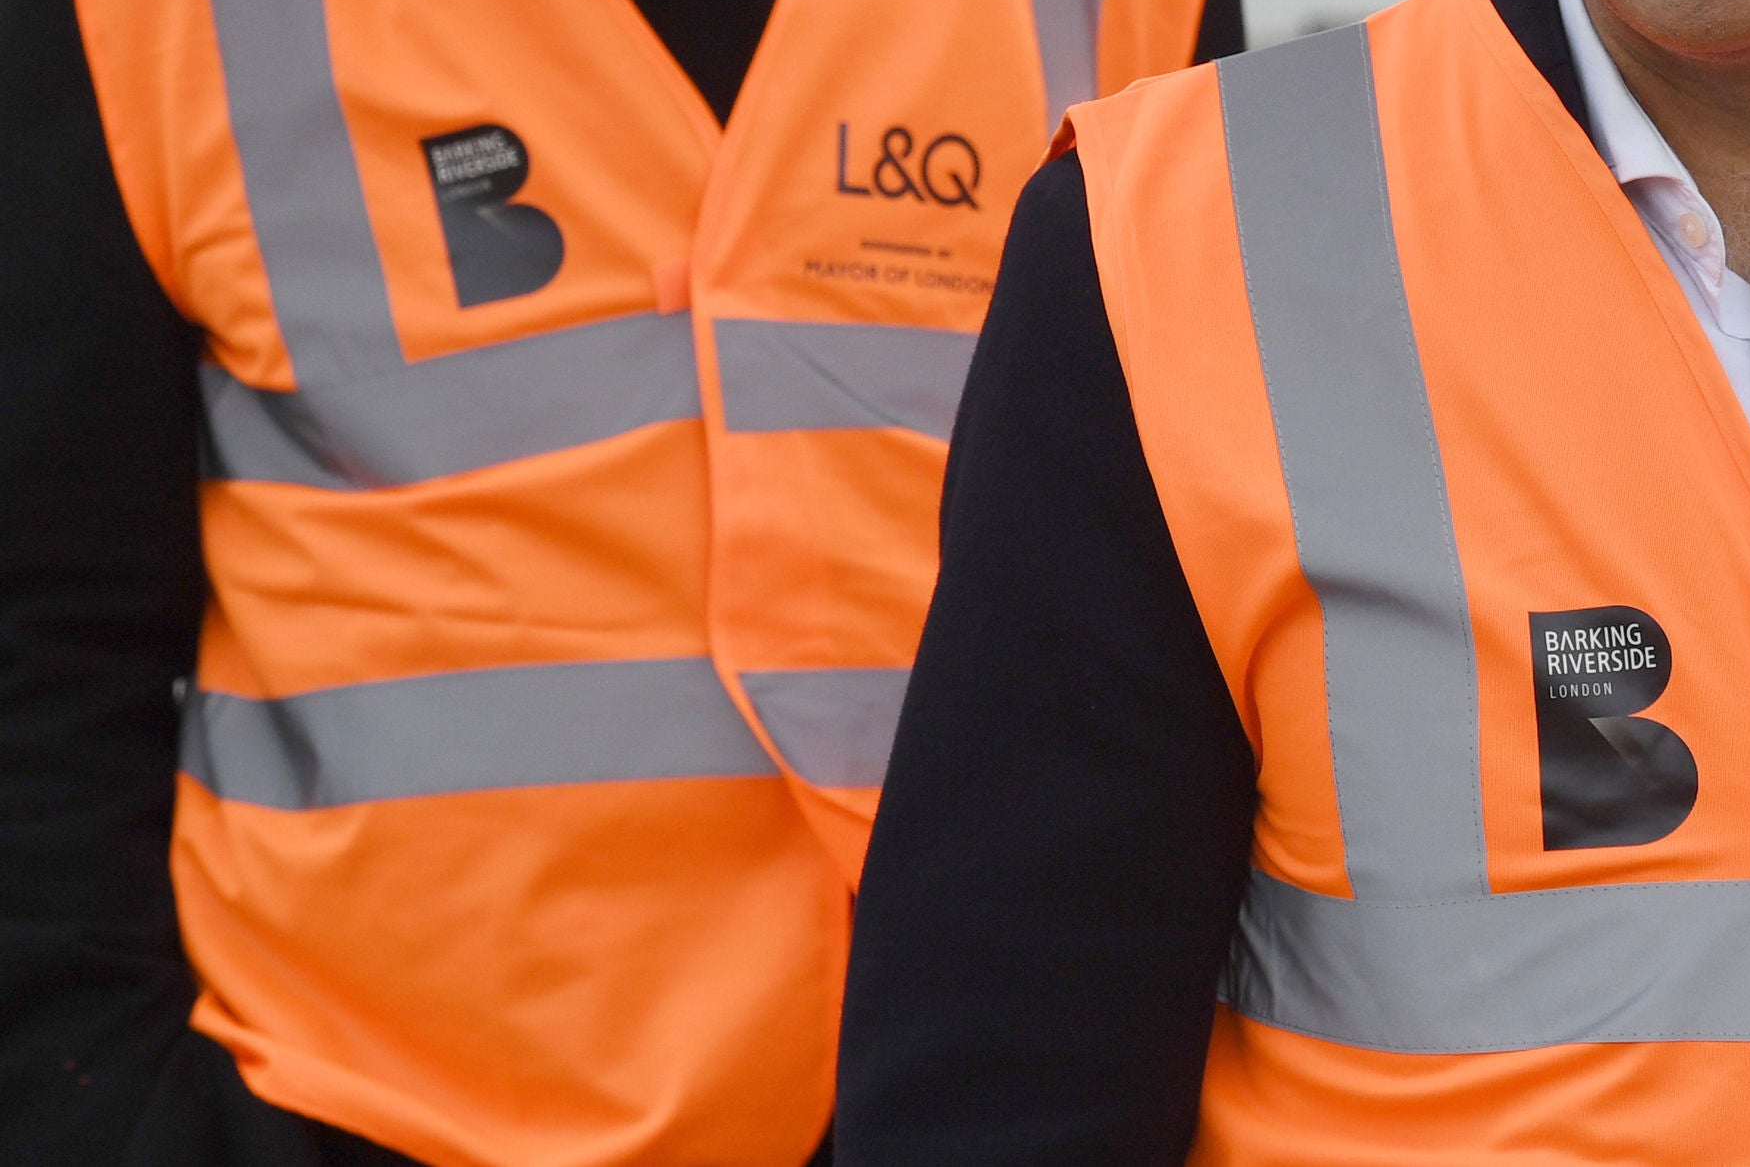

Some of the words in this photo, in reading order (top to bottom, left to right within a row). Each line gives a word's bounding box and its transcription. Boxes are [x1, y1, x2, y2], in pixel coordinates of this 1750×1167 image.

[838, 122, 980, 211] L&Q
[1545, 623, 1642, 652] BARKING
[1547, 646, 1657, 675] RIVERSIDE
[1549, 682, 1613, 699] LONDON
